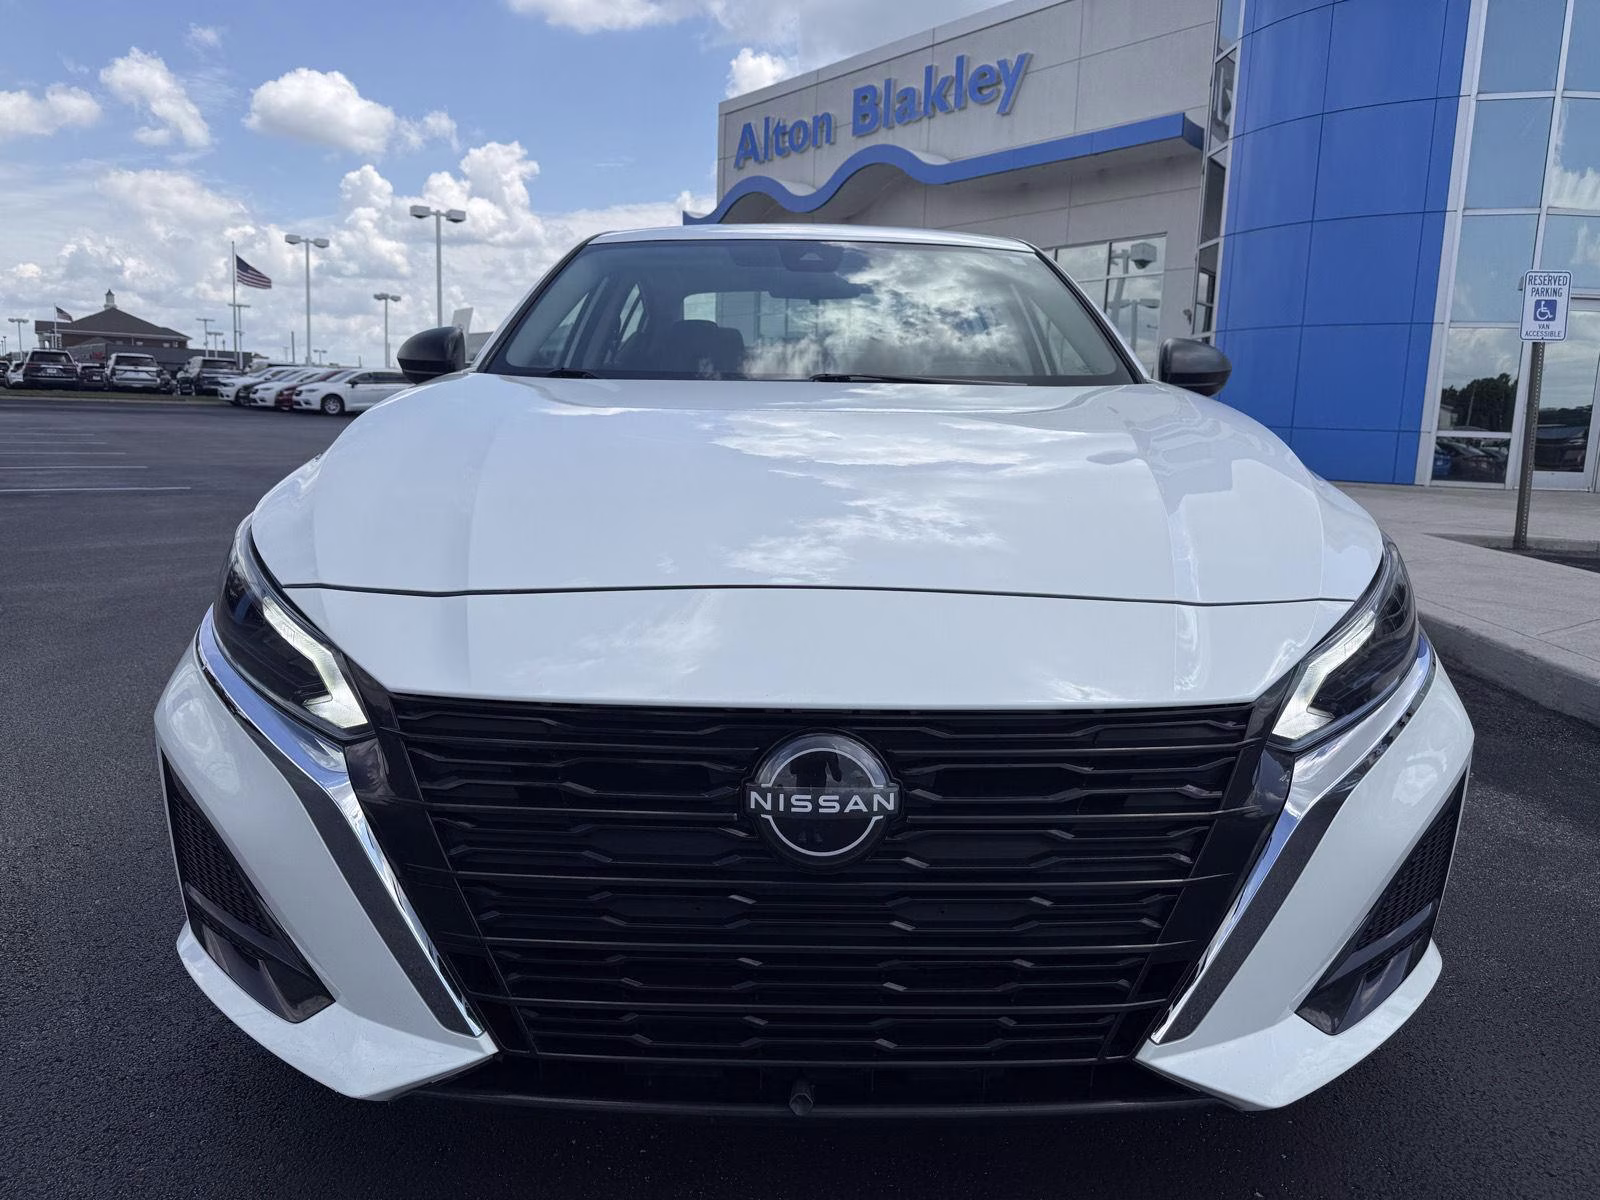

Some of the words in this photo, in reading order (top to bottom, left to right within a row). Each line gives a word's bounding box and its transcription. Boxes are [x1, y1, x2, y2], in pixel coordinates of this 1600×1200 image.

[734, 110, 834, 170] Alton
[851, 52, 1032, 137] Blakley
[1528, 275, 1568, 286] RESERVED
[1531, 287, 1563, 297] PARKING
[750, 791, 895, 813] NISSAN
